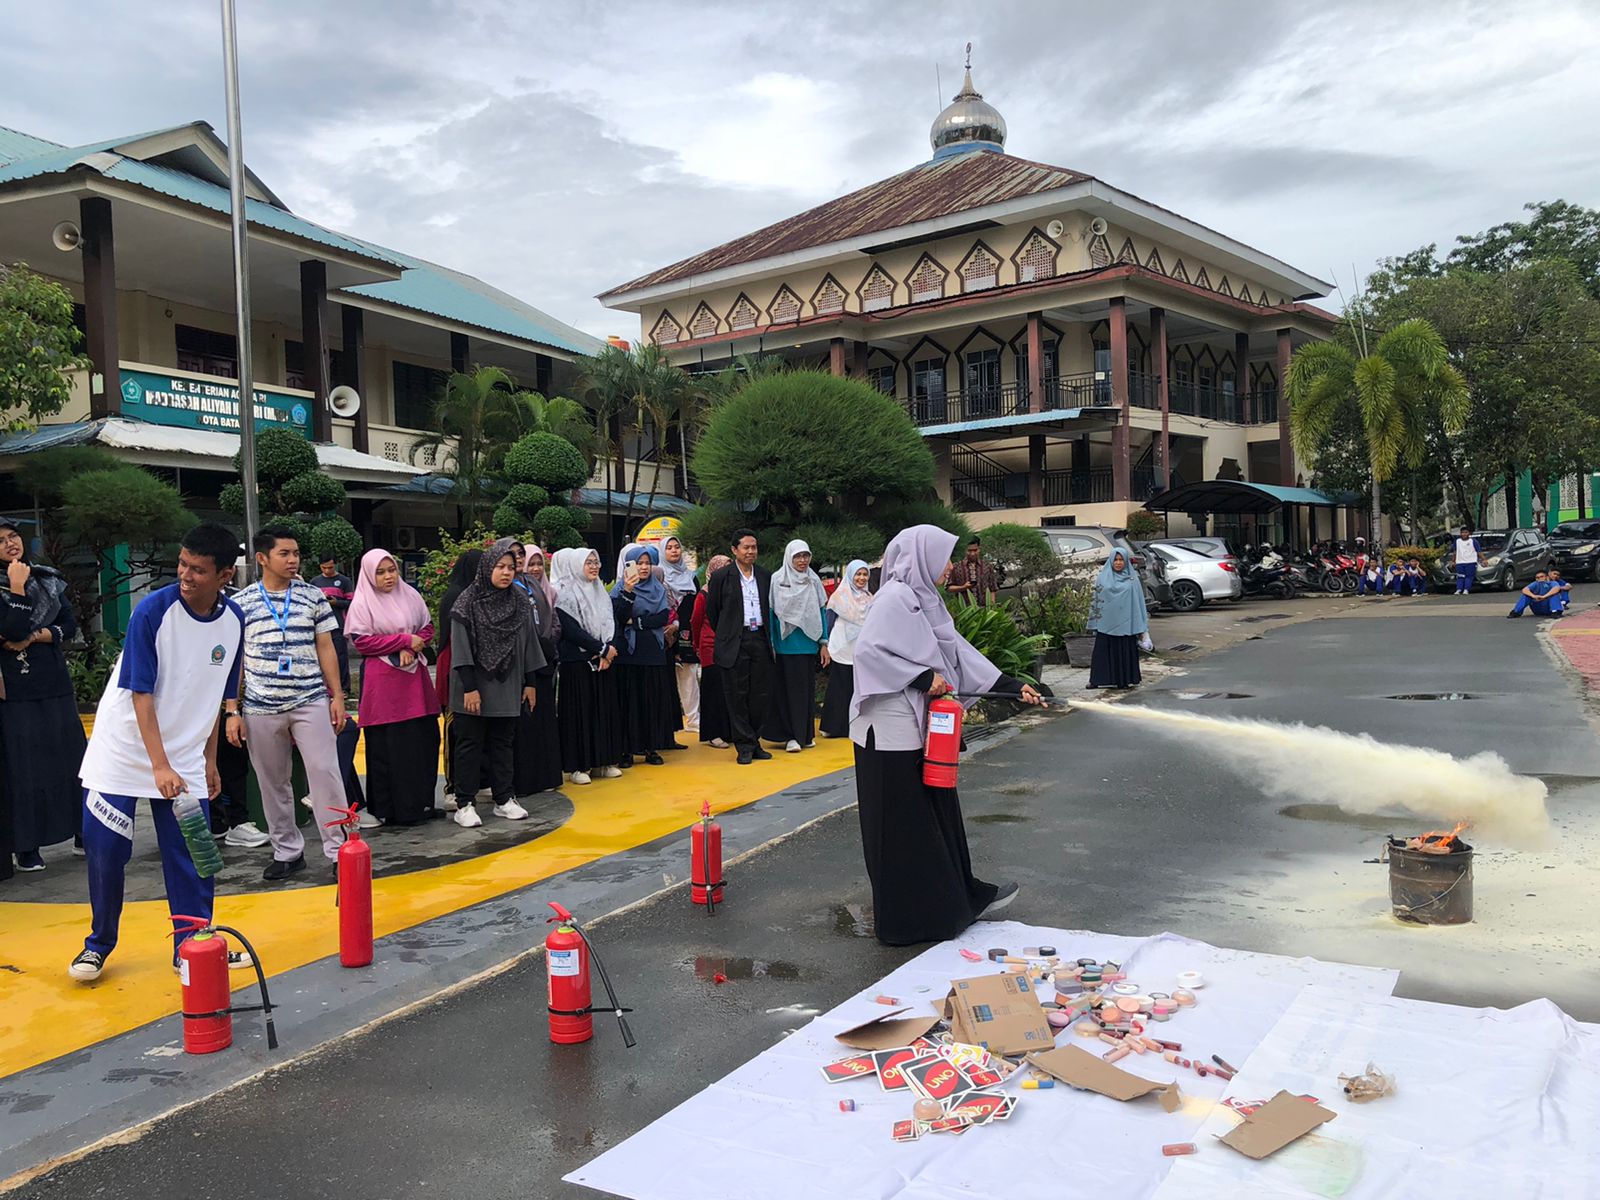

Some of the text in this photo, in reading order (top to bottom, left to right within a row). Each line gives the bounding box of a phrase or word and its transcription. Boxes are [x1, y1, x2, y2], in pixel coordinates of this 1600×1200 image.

[171, 380, 229, 397] KEENERIAN
[201, 397, 232, 415] ALIYAH
[94, 801, 130, 830] MAN BATAM
[842, 1058, 867, 1073] UNO
[926, 1069, 955, 1089] UNO
